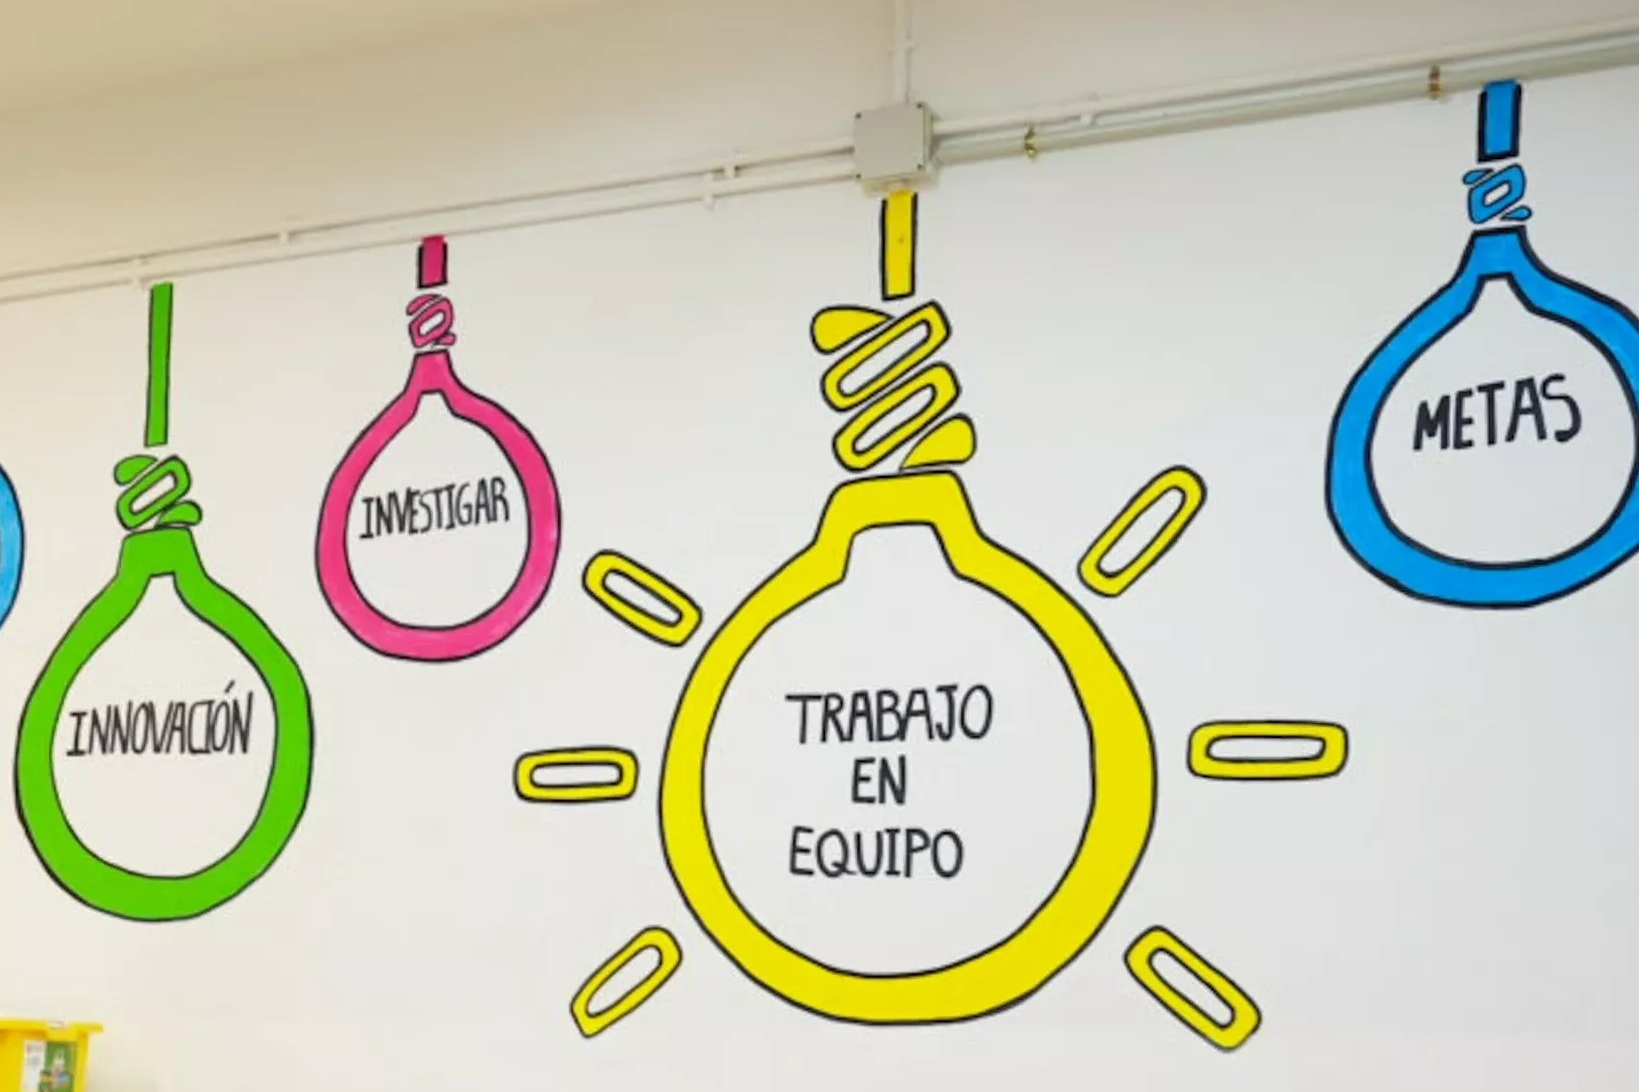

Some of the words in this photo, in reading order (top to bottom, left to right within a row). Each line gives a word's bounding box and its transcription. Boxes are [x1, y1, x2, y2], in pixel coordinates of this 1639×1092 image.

[1412, 372, 1582, 451] METAS
[359, 476, 511, 539] INVESTIGAR
[65, 680, 254, 757] INNOVACIÓN
[784, 683, 994, 745] TRABAJO
[851, 753, 907, 806] EN
[788, 824, 964, 879] EQUIPO
